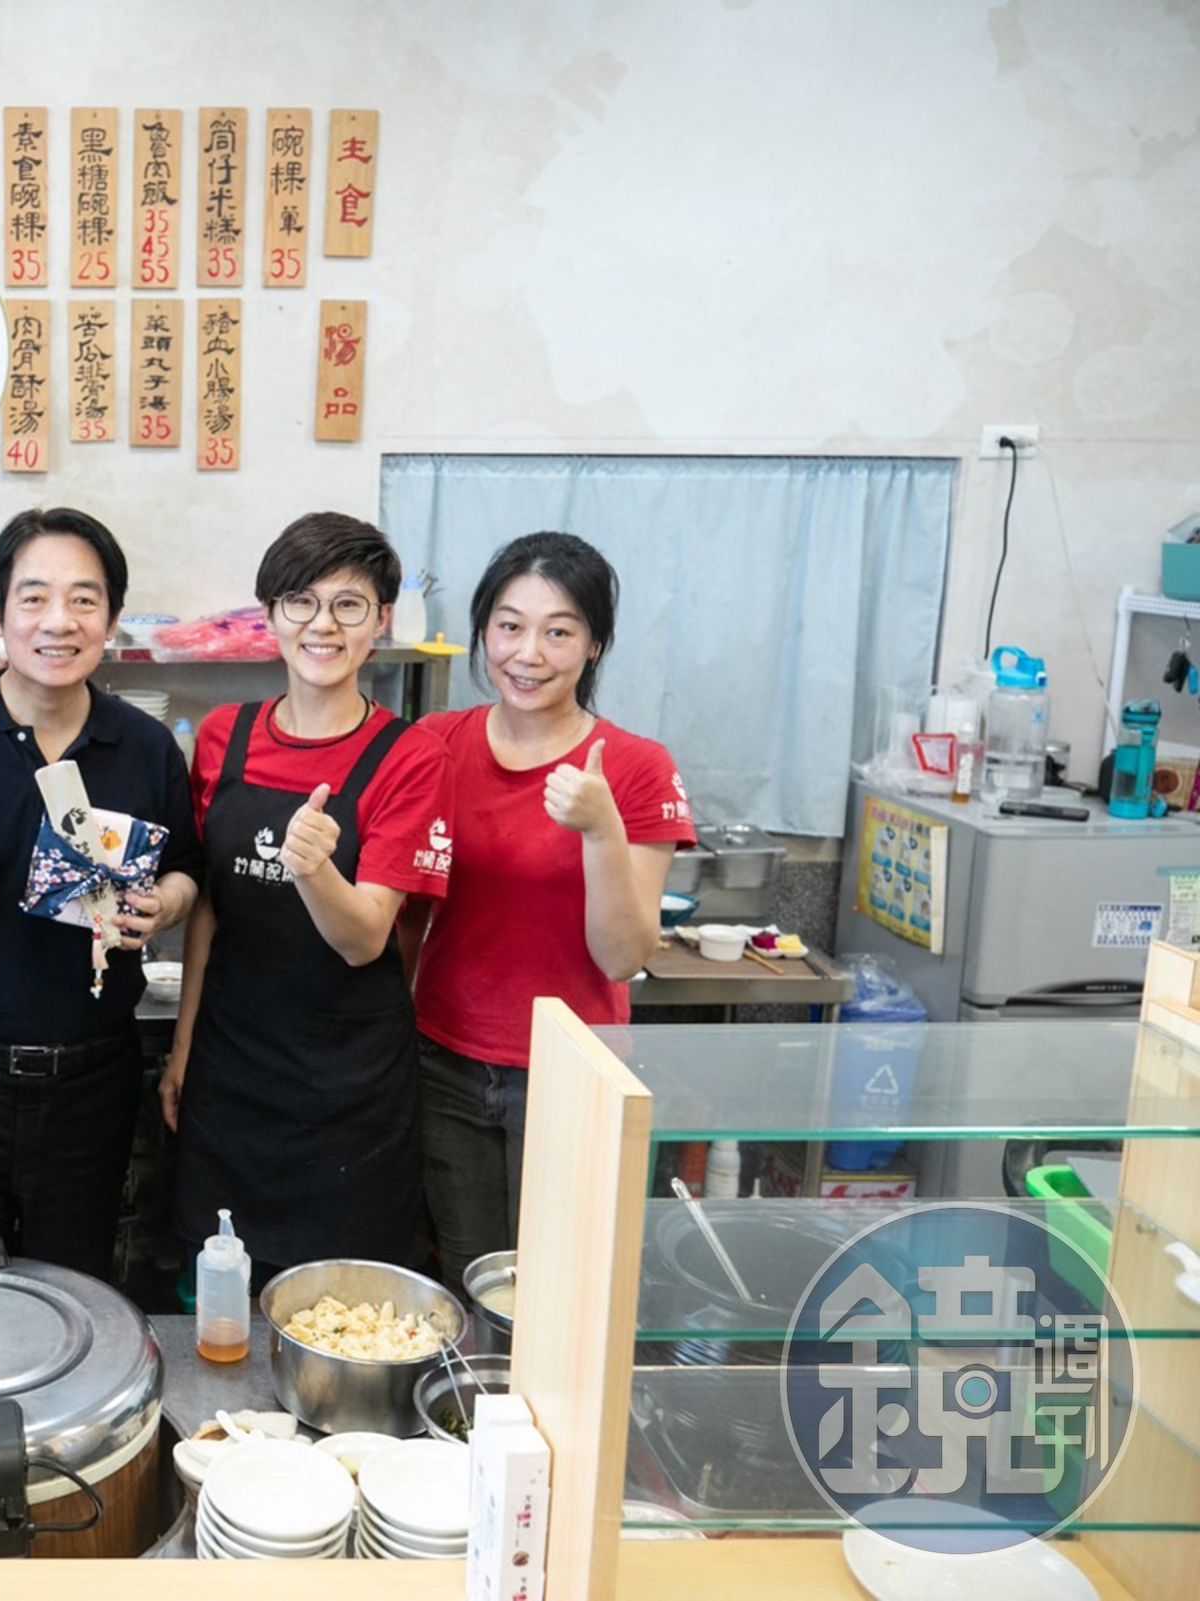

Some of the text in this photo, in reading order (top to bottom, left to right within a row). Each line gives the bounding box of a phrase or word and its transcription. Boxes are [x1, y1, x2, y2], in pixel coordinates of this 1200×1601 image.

[141, 121, 178, 207] 魯肉飯
[271, 126, 306, 195] 碗粿
[10, 122, 47, 243] 素食碗粿
[77, 127, 114, 246] 黑糖碗粿
[203, 120, 242, 244] 筒仔米糕
[335, 136, 373, 228] 主食
[144, 209, 169, 233] 35
[142, 235, 169, 258] 45
[12, 250, 41, 281] 35
[77, 251, 111, 280] 25
[141, 259, 169, 284] 55
[207, 248, 236, 279] 35
[271, 249, 301, 279] 35
[9, 316, 45, 435] 肉骨酥湯
[202, 312, 239, 435] 豬血小腸湯
[79, 420, 106, 440] 35
[140, 415, 171, 440] 35
[6, 440, 39, 468] 40
[205, 438, 234, 466] 35
